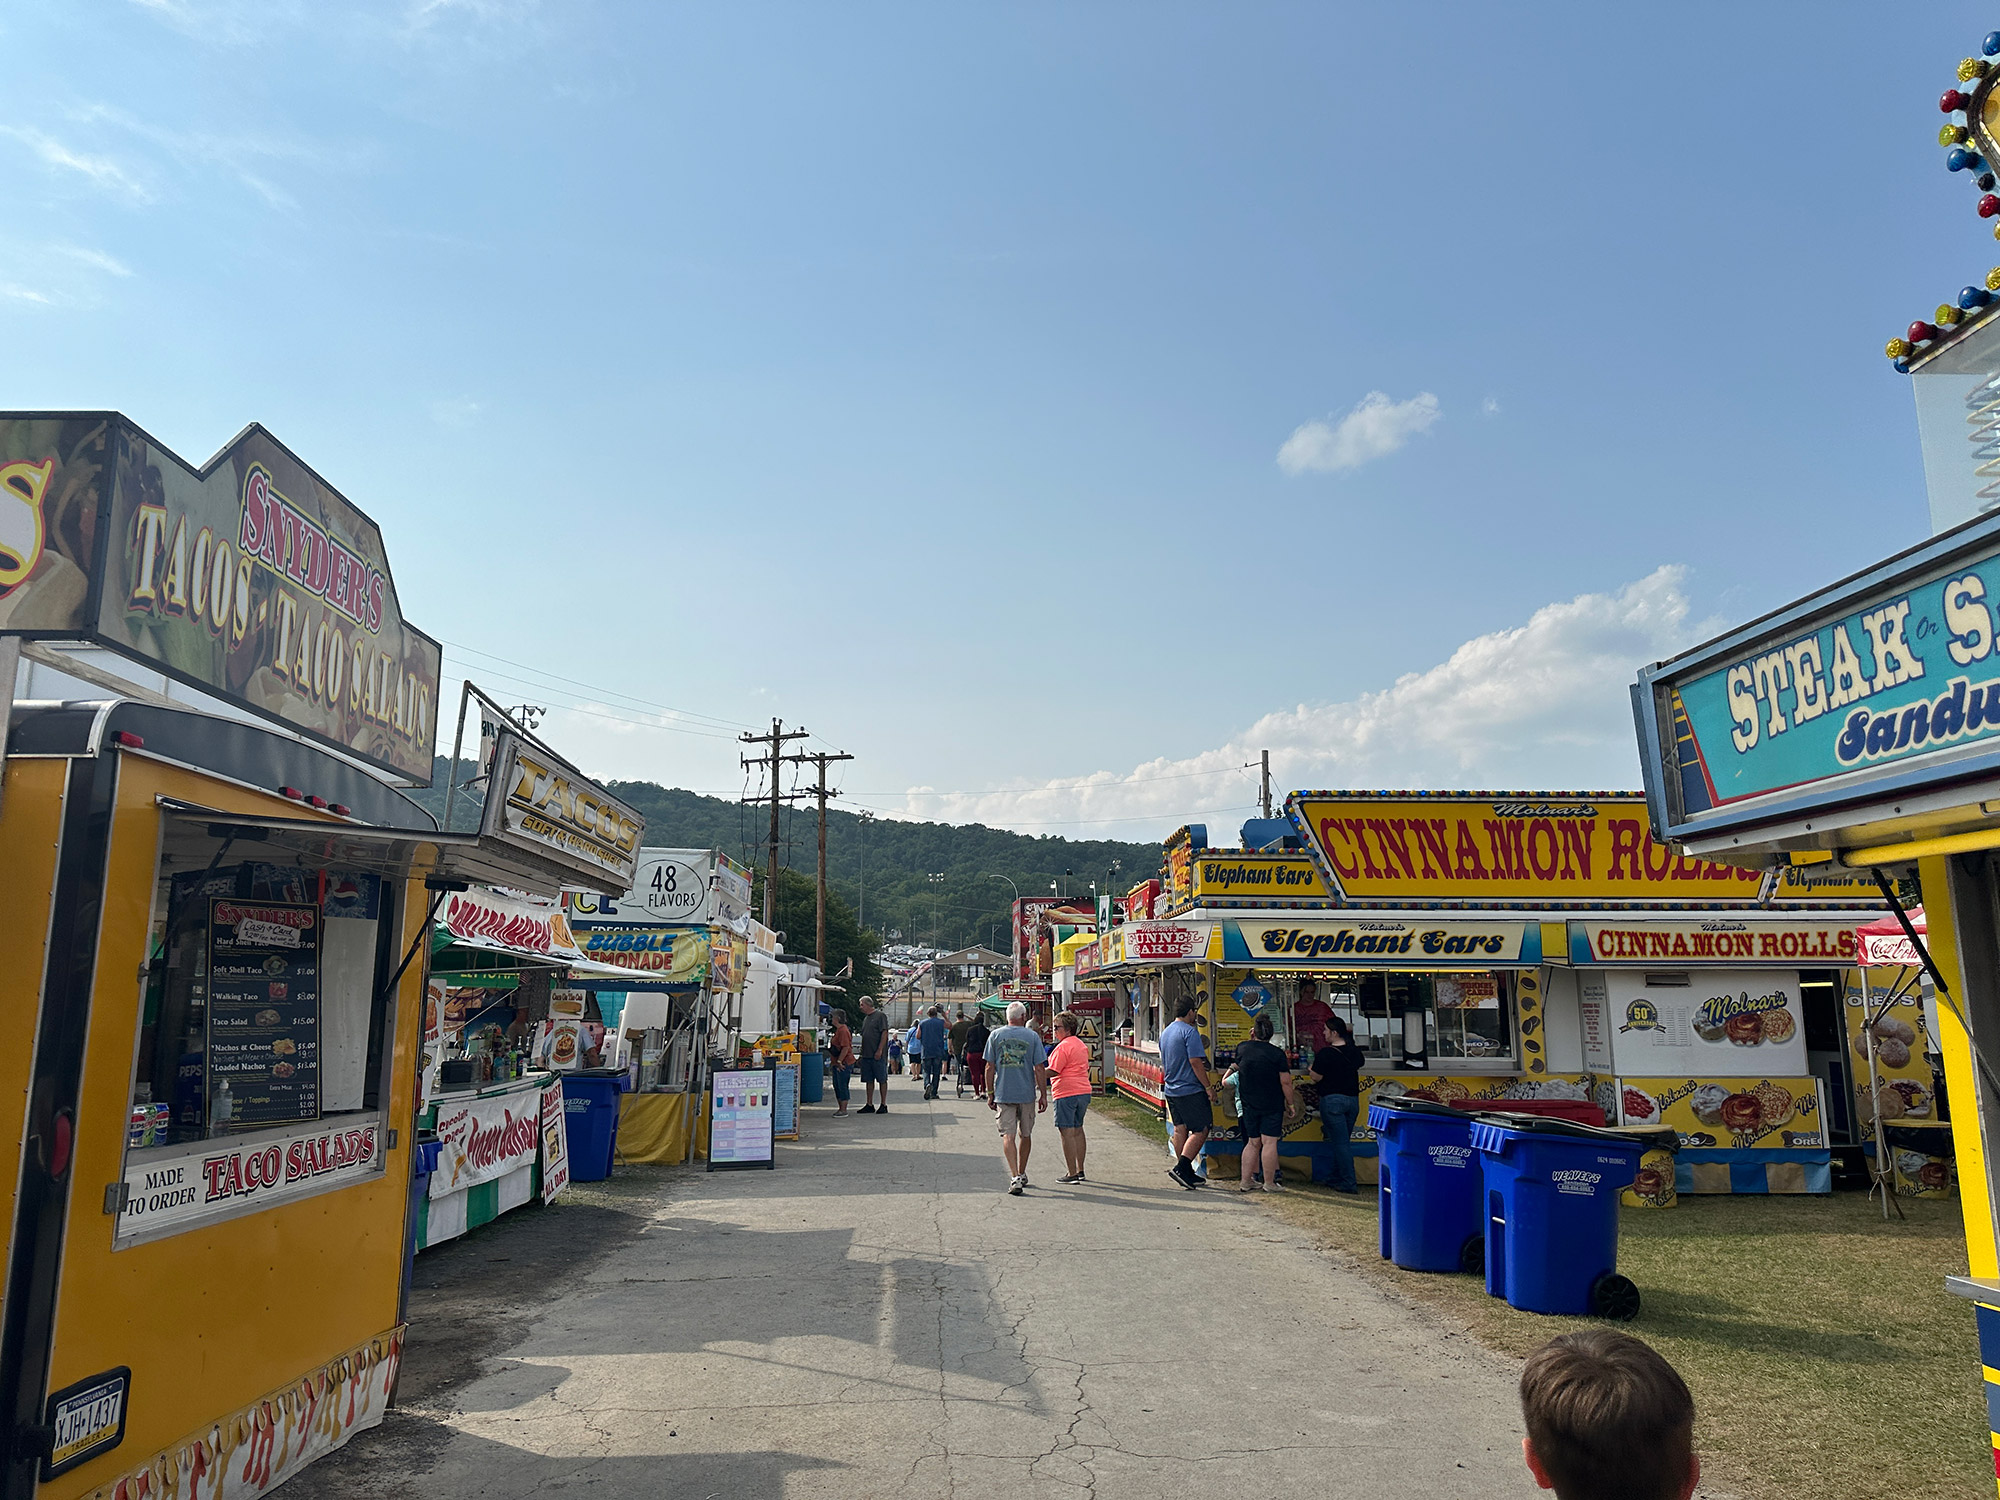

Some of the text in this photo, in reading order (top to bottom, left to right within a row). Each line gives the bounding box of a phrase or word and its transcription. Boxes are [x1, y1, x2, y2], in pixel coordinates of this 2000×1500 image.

[242, 463, 384, 635] SNYDER'S
[132, 502, 251, 646] TACOS
[273, 588, 344, 708] TACO
[349, 637, 429, 747] SALADS
[1726, 595, 1925, 754] STEAK
[510, 755, 640, 855] TACOS
[1492, 803, 1599, 818] Molnar's
[520, 815, 559, 839] SOFT
[556, 830, 568, 847] &
[568, 834, 598, 858] HARD
[1320, 817, 1596, 881] CINNAMON
[651, 865, 677, 893] 48
[1204, 863, 1273, 889] Elephant
[1274, 865, 1314, 886] Ears
[648, 893, 697, 908] FLAVORS
[215, 904, 314, 929] SNYDER'S
[244, 920, 266, 933] Cash
[272, 925, 294, 936] Card
[1127, 931, 1204, 945] FUNNEL
[1141, 922, 1178, 934] Molnar's
[216, 937, 234, 946] Hard
[586, 934, 678, 952] BUBBLE
[1133, 942, 1193, 956] CAKES
[1260, 928, 1505, 957] Elephant Ears
[1597, 929, 1855, 958] CINNAMON ROLLS
[213, 965, 227, 974] Soft
[229, 965, 245, 974] Shell
[246, 966, 263, 974] Taco
[215, 993, 242, 1001] Walking
[1703, 990, 1788, 1027] Molnar's
[212, 1018, 228, 1026] Taco
[230, 1018, 248, 1026] Salad
[214, 1043, 239, 1052] Nachos
[249, 1043, 272, 1051] Cheese
[179, 1065, 202, 1078] PEPS
[214, 1063, 240, 1071] Loaded
[241, 1062, 266, 1070] Nachos
[248, 1096, 271, 1104] Toppings
[1428, 1145, 1473, 1158] WEAVER'S
[202, 1127, 375, 1204] TACO SALADS
[144, 1167, 185, 1191] MADE
[554, 1167, 567, 1188] DAY
[1552, 1170, 1602, 1184] WEAVER'S
[127, 1186, 196, 1217] TO ORDER
[72, 1388, 108, 1409] PENNSYLVANIA
[70, 1432, 101, 1452] TRAILER
